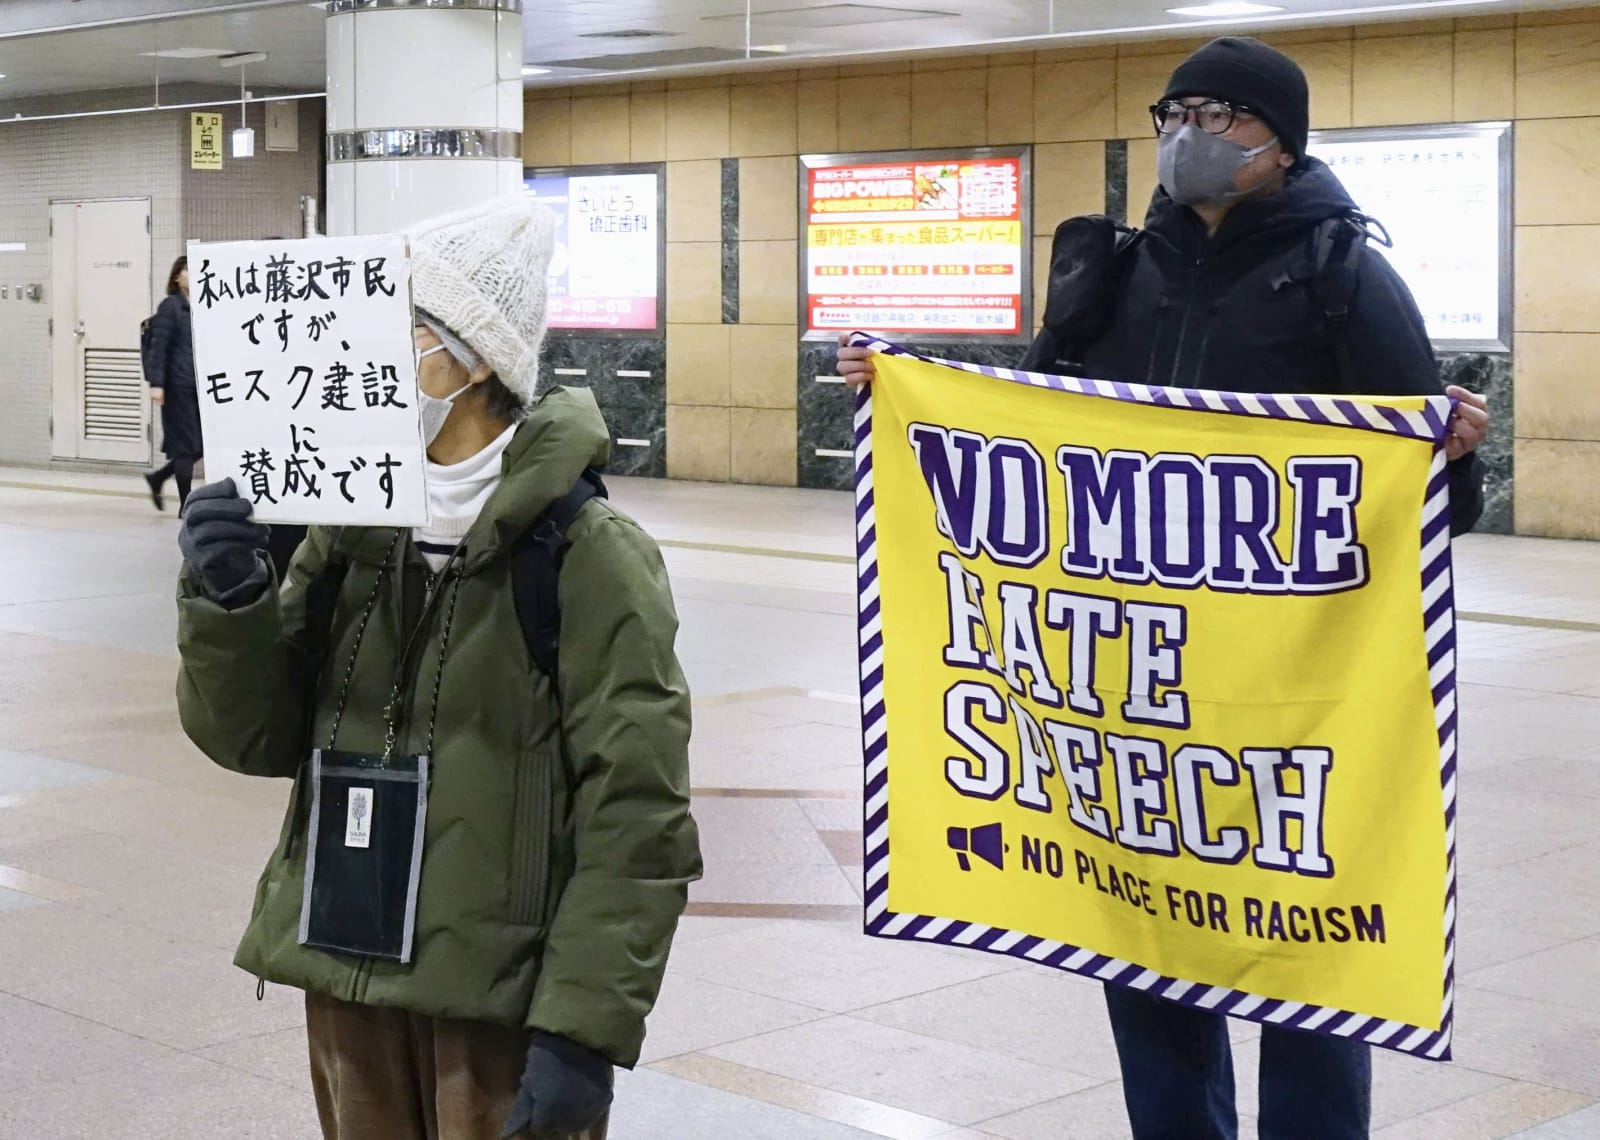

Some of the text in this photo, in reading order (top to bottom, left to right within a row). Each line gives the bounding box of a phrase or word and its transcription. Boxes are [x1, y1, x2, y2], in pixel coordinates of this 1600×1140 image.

[576, 194, 634, 213] さいとう
[589, 215, 648, 232] 矯正歯科
[197, 252, 396, 309] 私は藤沢市民
[241, 308, 351, 352] ですが、
[206, 361, 408, 411] モスク建設
[290, 424, 320, 453] に
[239, 447, 403, 510] 賛成です
[907, 421, 1370, 596] NO MORE
[938, 551, 1190, 730] HATE
[943, 679, 1335, 879] SPEECH
[1022, 834, 1387, 944] NO PLACE FOR RACISM
